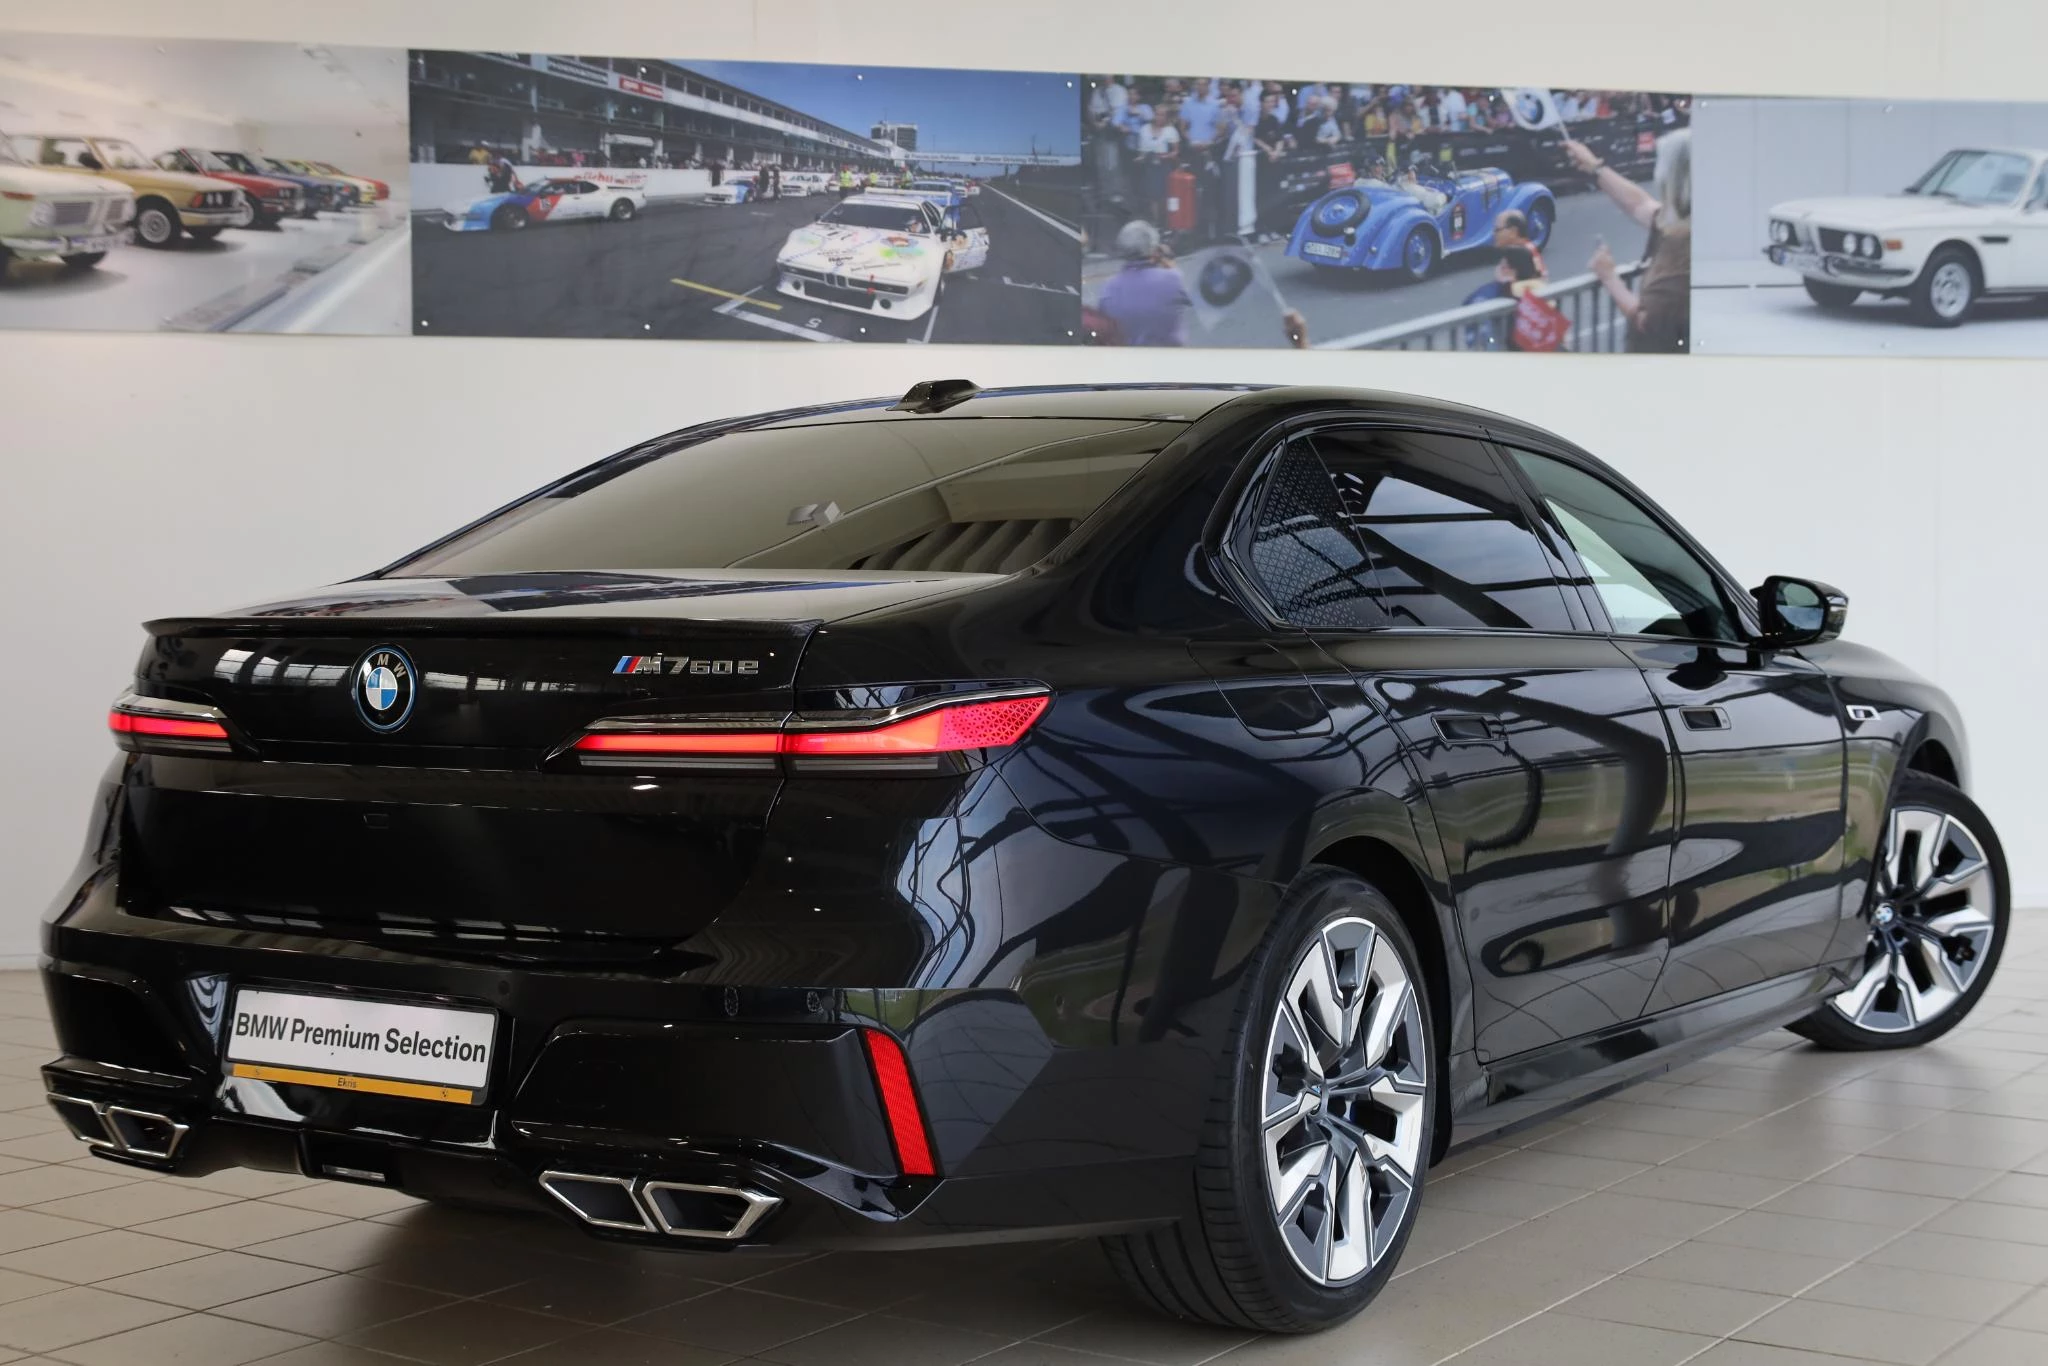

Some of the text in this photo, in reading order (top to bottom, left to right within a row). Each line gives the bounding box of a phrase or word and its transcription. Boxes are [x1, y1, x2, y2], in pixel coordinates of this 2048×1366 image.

[235, 1012, 486, 1063] BMW Premium Selection
